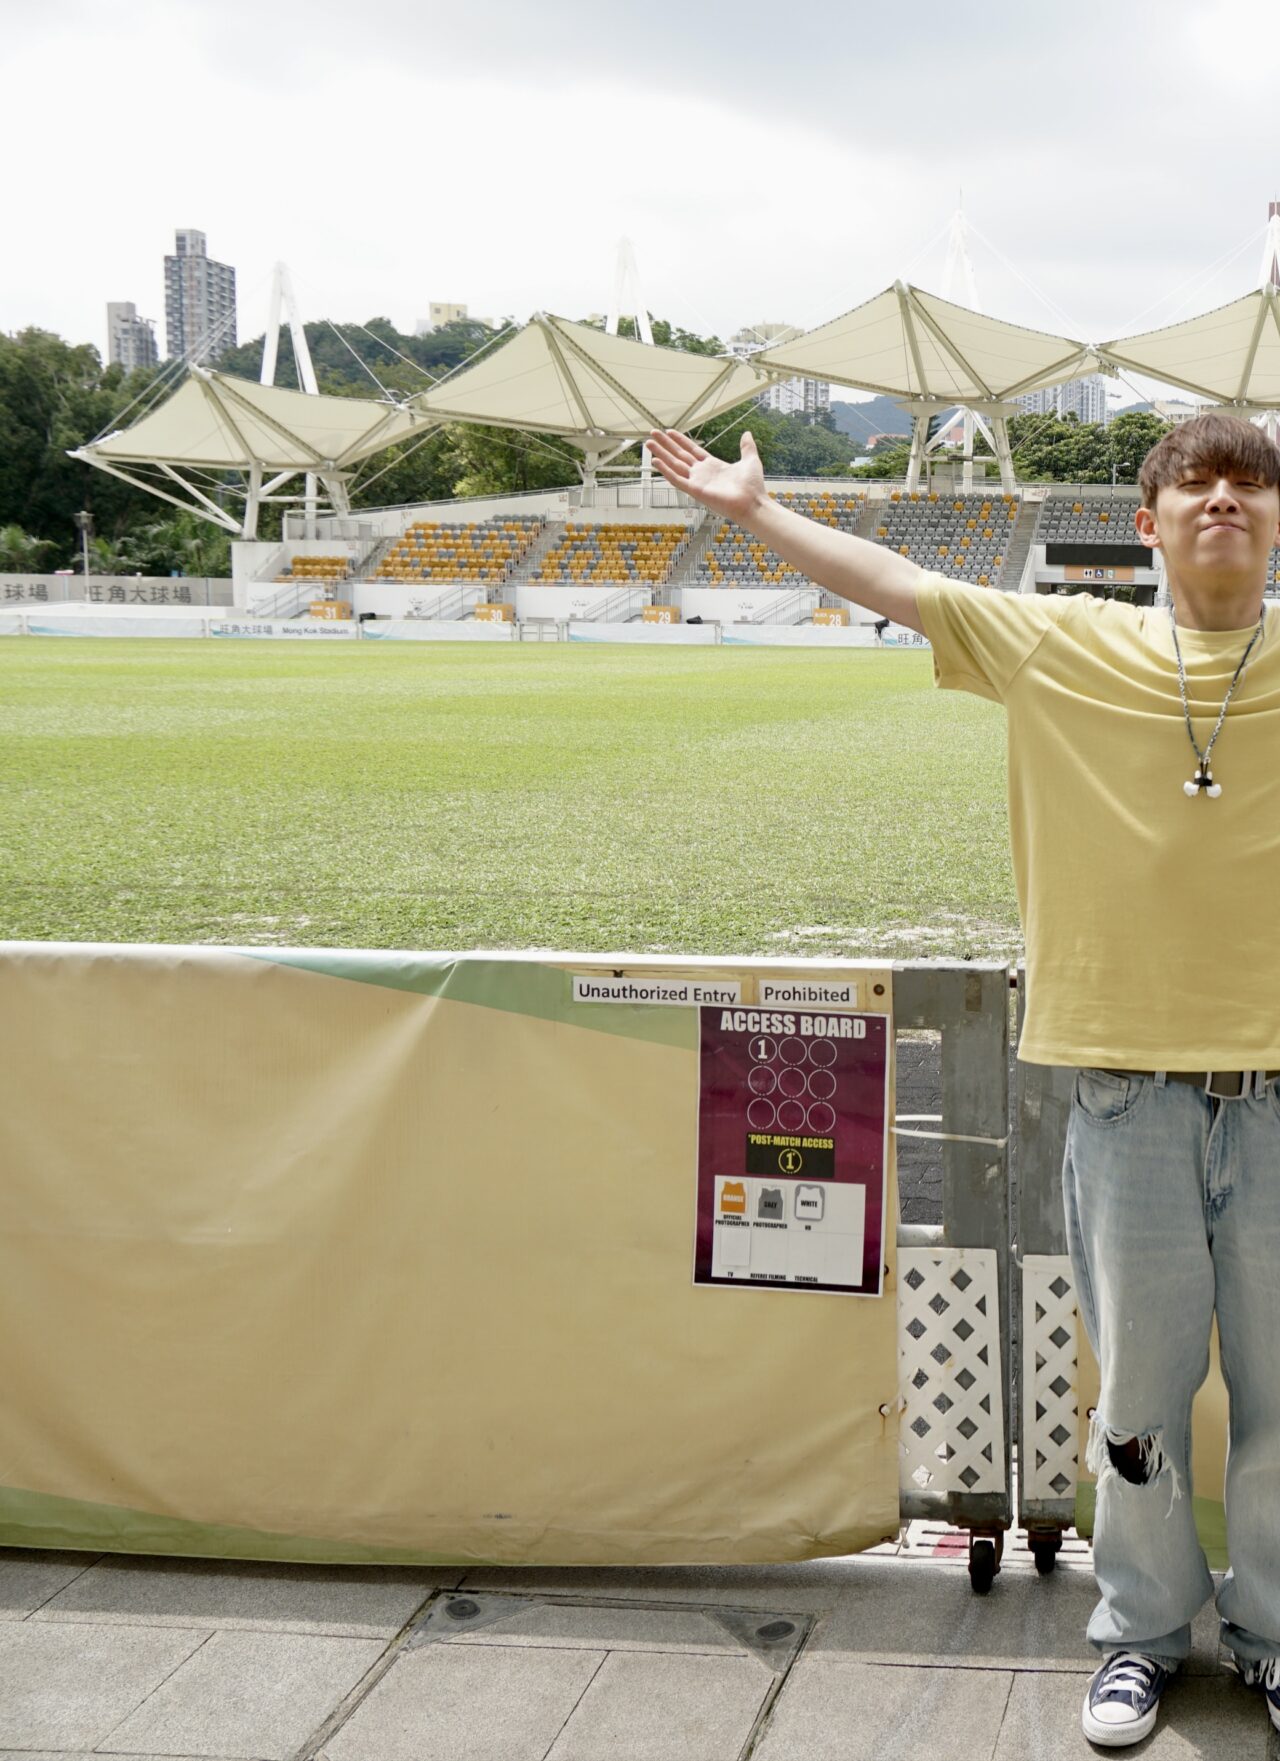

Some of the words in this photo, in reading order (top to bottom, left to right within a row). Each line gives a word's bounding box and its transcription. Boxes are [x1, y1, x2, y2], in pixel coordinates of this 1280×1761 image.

[0, 583, 48, 601] 球場
[84, 585, 192, 603] 旺角大球場
[659, 611, 670, 624] 29
[220, 624, 273, 635] 旺角大球場
[282, 627, 302, 635] Mong
[579, 983, 688, 1001] Unauthorized
[694, 988, 737, 1003] Entry
[764, 986, 850, 1002] Prohibited
[720, 1010, 796, 1035] ACCESS
[800, 1015, 866, 1039] BOARD
[757, 1039, 768, 1059] 1
[802, 1137, 834, 1149] ACCESS
[801, 1200, 817, 1208] WHITE
[715, 1219, 750, 1227] PHOTOGRAPHER
[753, 1221, 788, 1229] PHOTOGRAPHER
